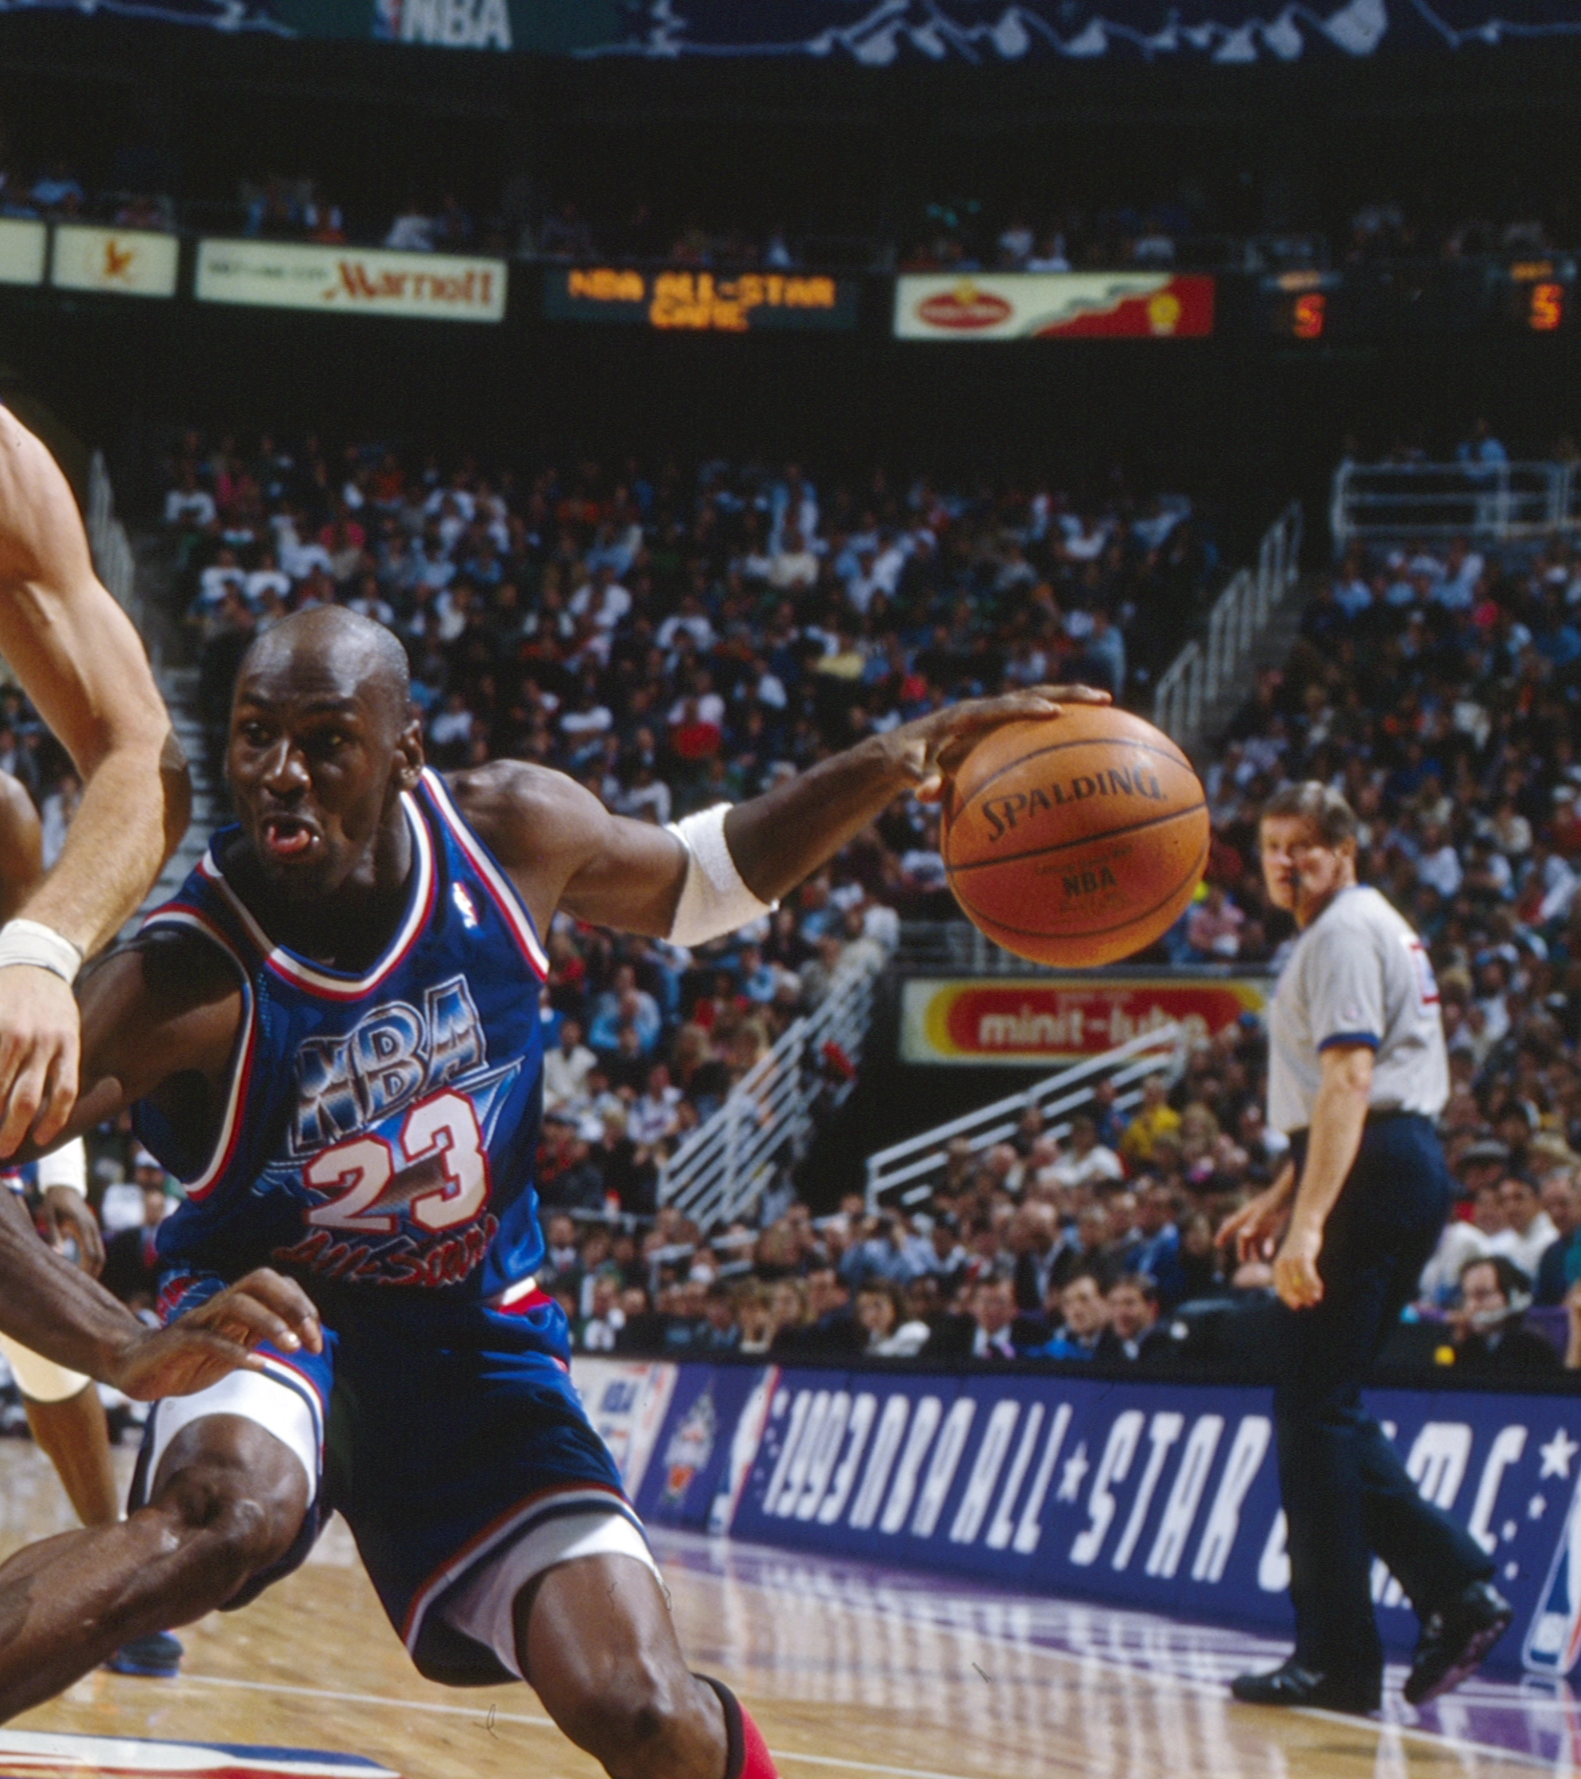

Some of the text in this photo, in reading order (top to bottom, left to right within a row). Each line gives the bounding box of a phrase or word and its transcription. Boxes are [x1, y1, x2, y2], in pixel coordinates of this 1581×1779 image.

[402, 0, 512, 51] NBA
[1529, 284, 1564, 330] 5
[982, 762, 1163, 842] SPALDING
[1062, 865, 1118, 899] NBA
[287, 972, 489, 1158] NBA
[303, 1086, 492, 1236] 23
[763, 1389, 877, 1525] 1993
[850, 1393, 976, 1538] NBA
[950, 1399, 1073, 1555] ALL
[1069, 1409, 1272, 1584] STAR
